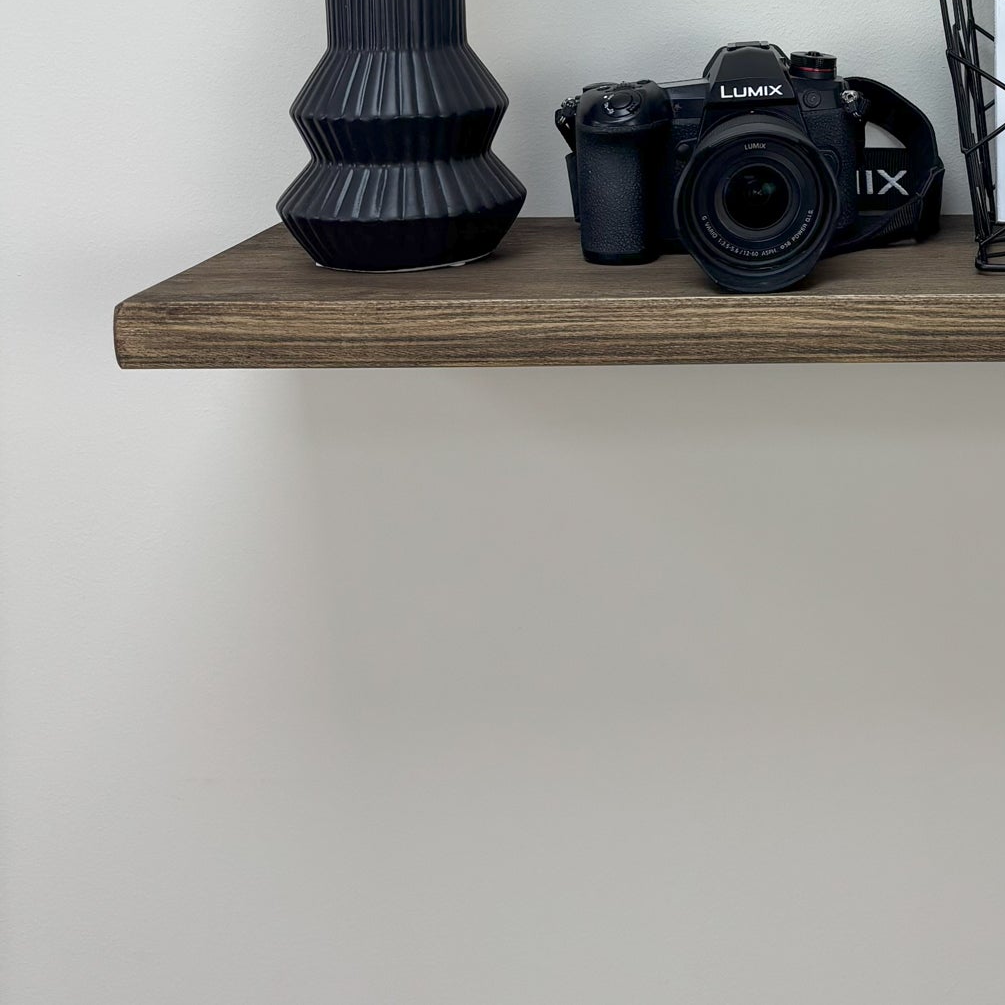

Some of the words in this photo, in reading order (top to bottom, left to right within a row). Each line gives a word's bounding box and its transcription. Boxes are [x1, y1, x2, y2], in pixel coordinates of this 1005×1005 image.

[720, 85, 783, 99] LUMIX
[856, 170, 909, 195] IX
[704, 221, 717, 238] VARIO
[791, 223, 807, 242] POWER
